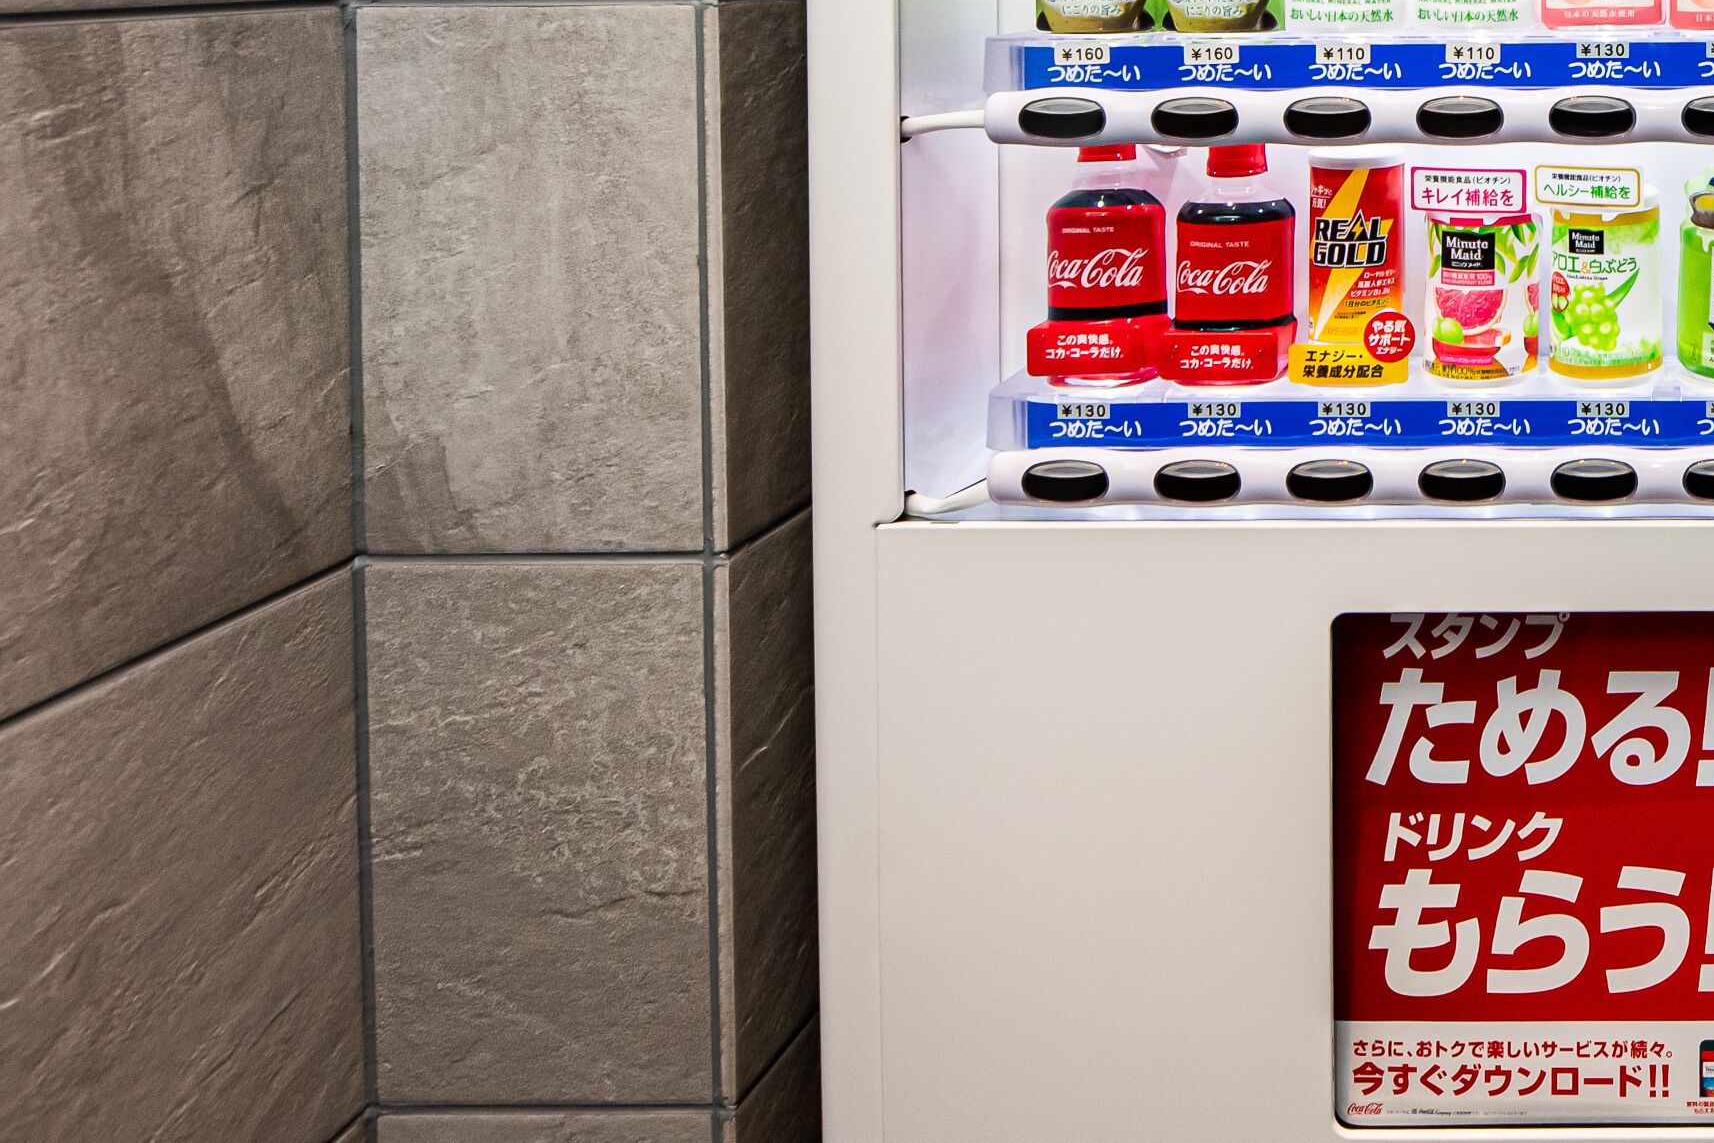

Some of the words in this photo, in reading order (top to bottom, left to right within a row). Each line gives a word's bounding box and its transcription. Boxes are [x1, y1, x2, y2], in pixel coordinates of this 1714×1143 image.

[1290, 8, 1394, 23] おいしい日本の天然水
[1417, 7, 1519, 23] おいしい日本の天然水
[1062, 47, 1104, 61] ¥160
[1191, 47, 1233, 60] ¥160
[1323, 47, 1364, 60] ¥110
[1453, 46, 1495, 60] ¥110
[1581, 44, 1625, 56] ¥130
[1422, 188, 1514, 207] キレイ補給を
[1544, 184, 1630, 200] ヘルシー補給を
[1316, 209, 1388, 240] REAL
[1446, 236, 1488, 250] Minute
[1572, 232, 1600, 242] Minute
[1575, 240, 1596, 249] Maid
[1313, 240, 1387, 268] GOLD
[1451, 248, 1482, 261] Maid
[1048, 248, 1148, 288] Coca-Cola
[1177, 260, 1272, 295] Coca-Cola
[1368, 333, 1411, 346] サポート
[1303, 364, 1384, 378] 栄養成分配合
[1062, 404, 1106, 417] ¥130
[1192, 404, 1236, 416] ¥130
[1322, 403, 1366, 415] ¥130
[1452, 402, 1496, 415] ¥130
[1581, 403, 1625, 416] ¥130
[1383, 612, 1571, 659] スタンプ
[1384, 811, 1564, 862] ドリンク
[1352, 1040, 1673, 1059] さらに、おトクで楽しいサービスが続々。
[1352, 1062, 1670, 1098] 今すぐダウンロード!!
